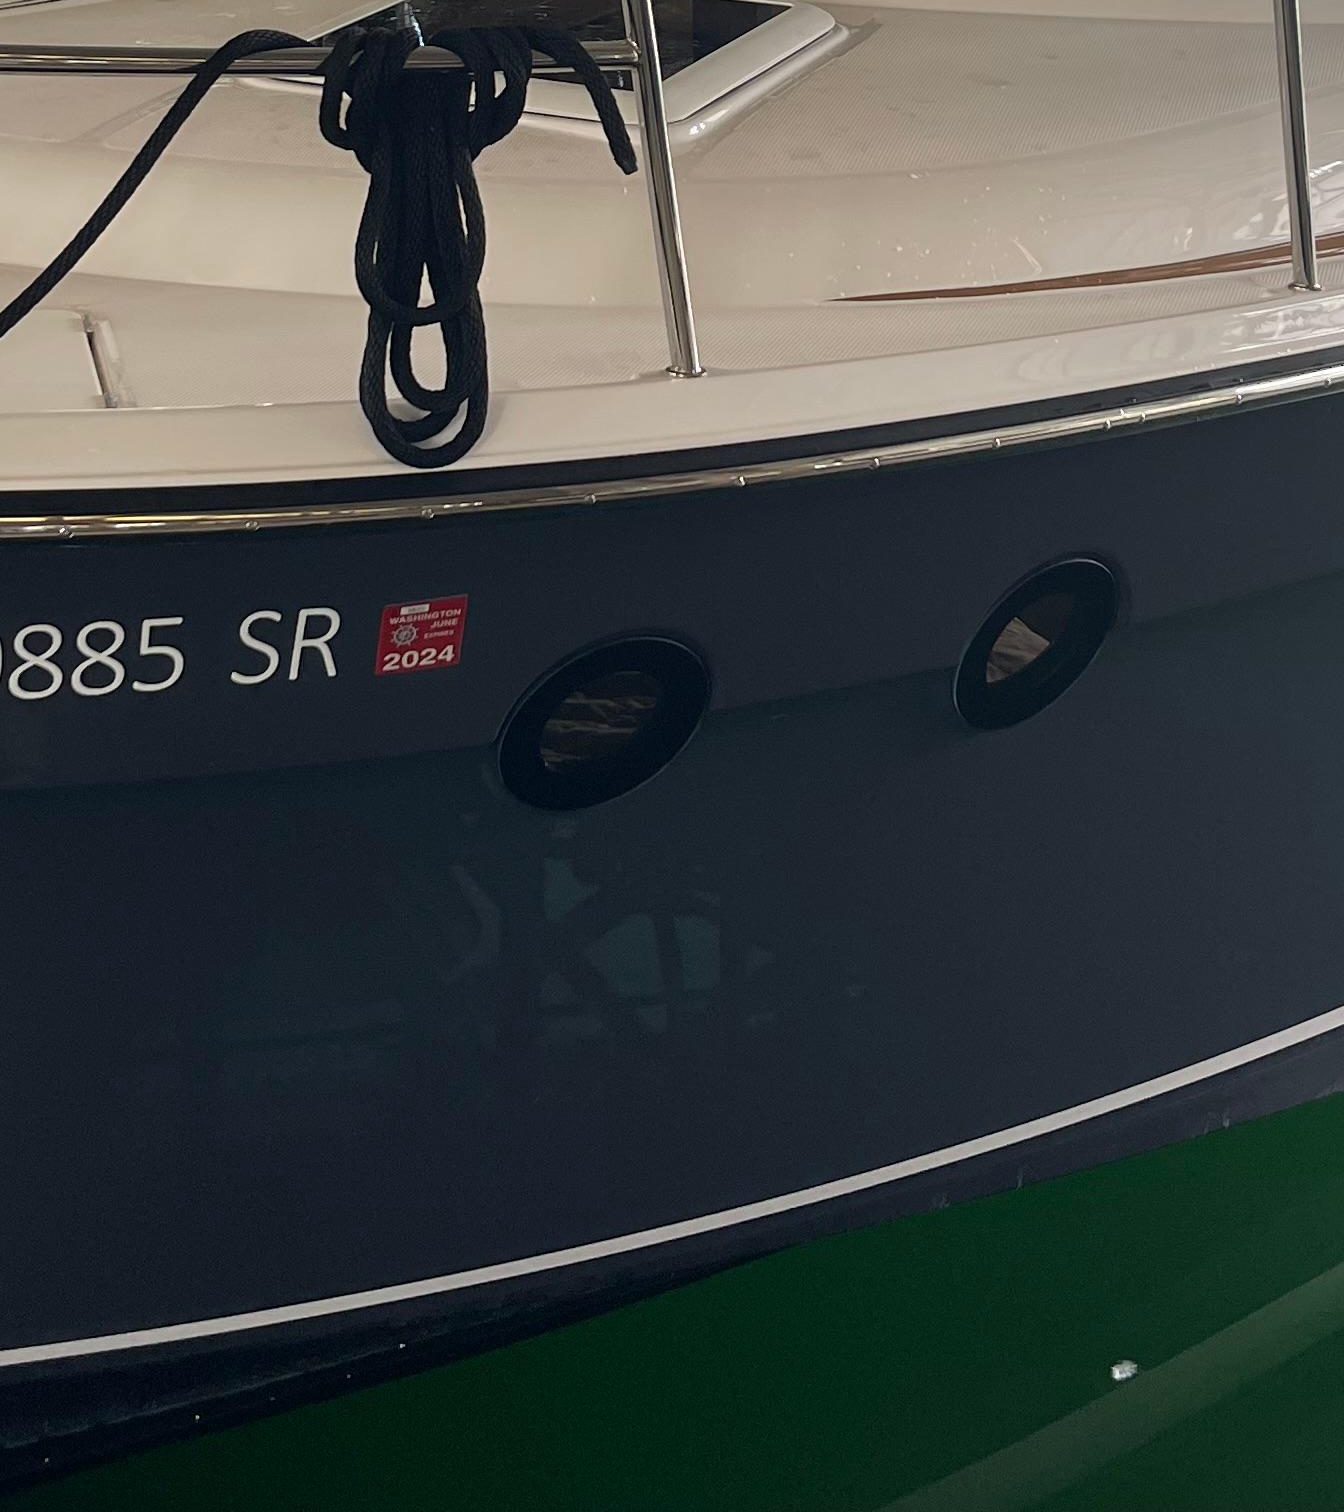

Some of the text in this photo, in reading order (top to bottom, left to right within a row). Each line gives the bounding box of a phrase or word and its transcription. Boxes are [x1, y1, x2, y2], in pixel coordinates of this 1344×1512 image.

[390, 609, 462, 625] WASHINGTON
[430, 618, 458, 630] JUNE
[230, 607, 341, 685] SR
[382, 644, 455, 671] 2024
